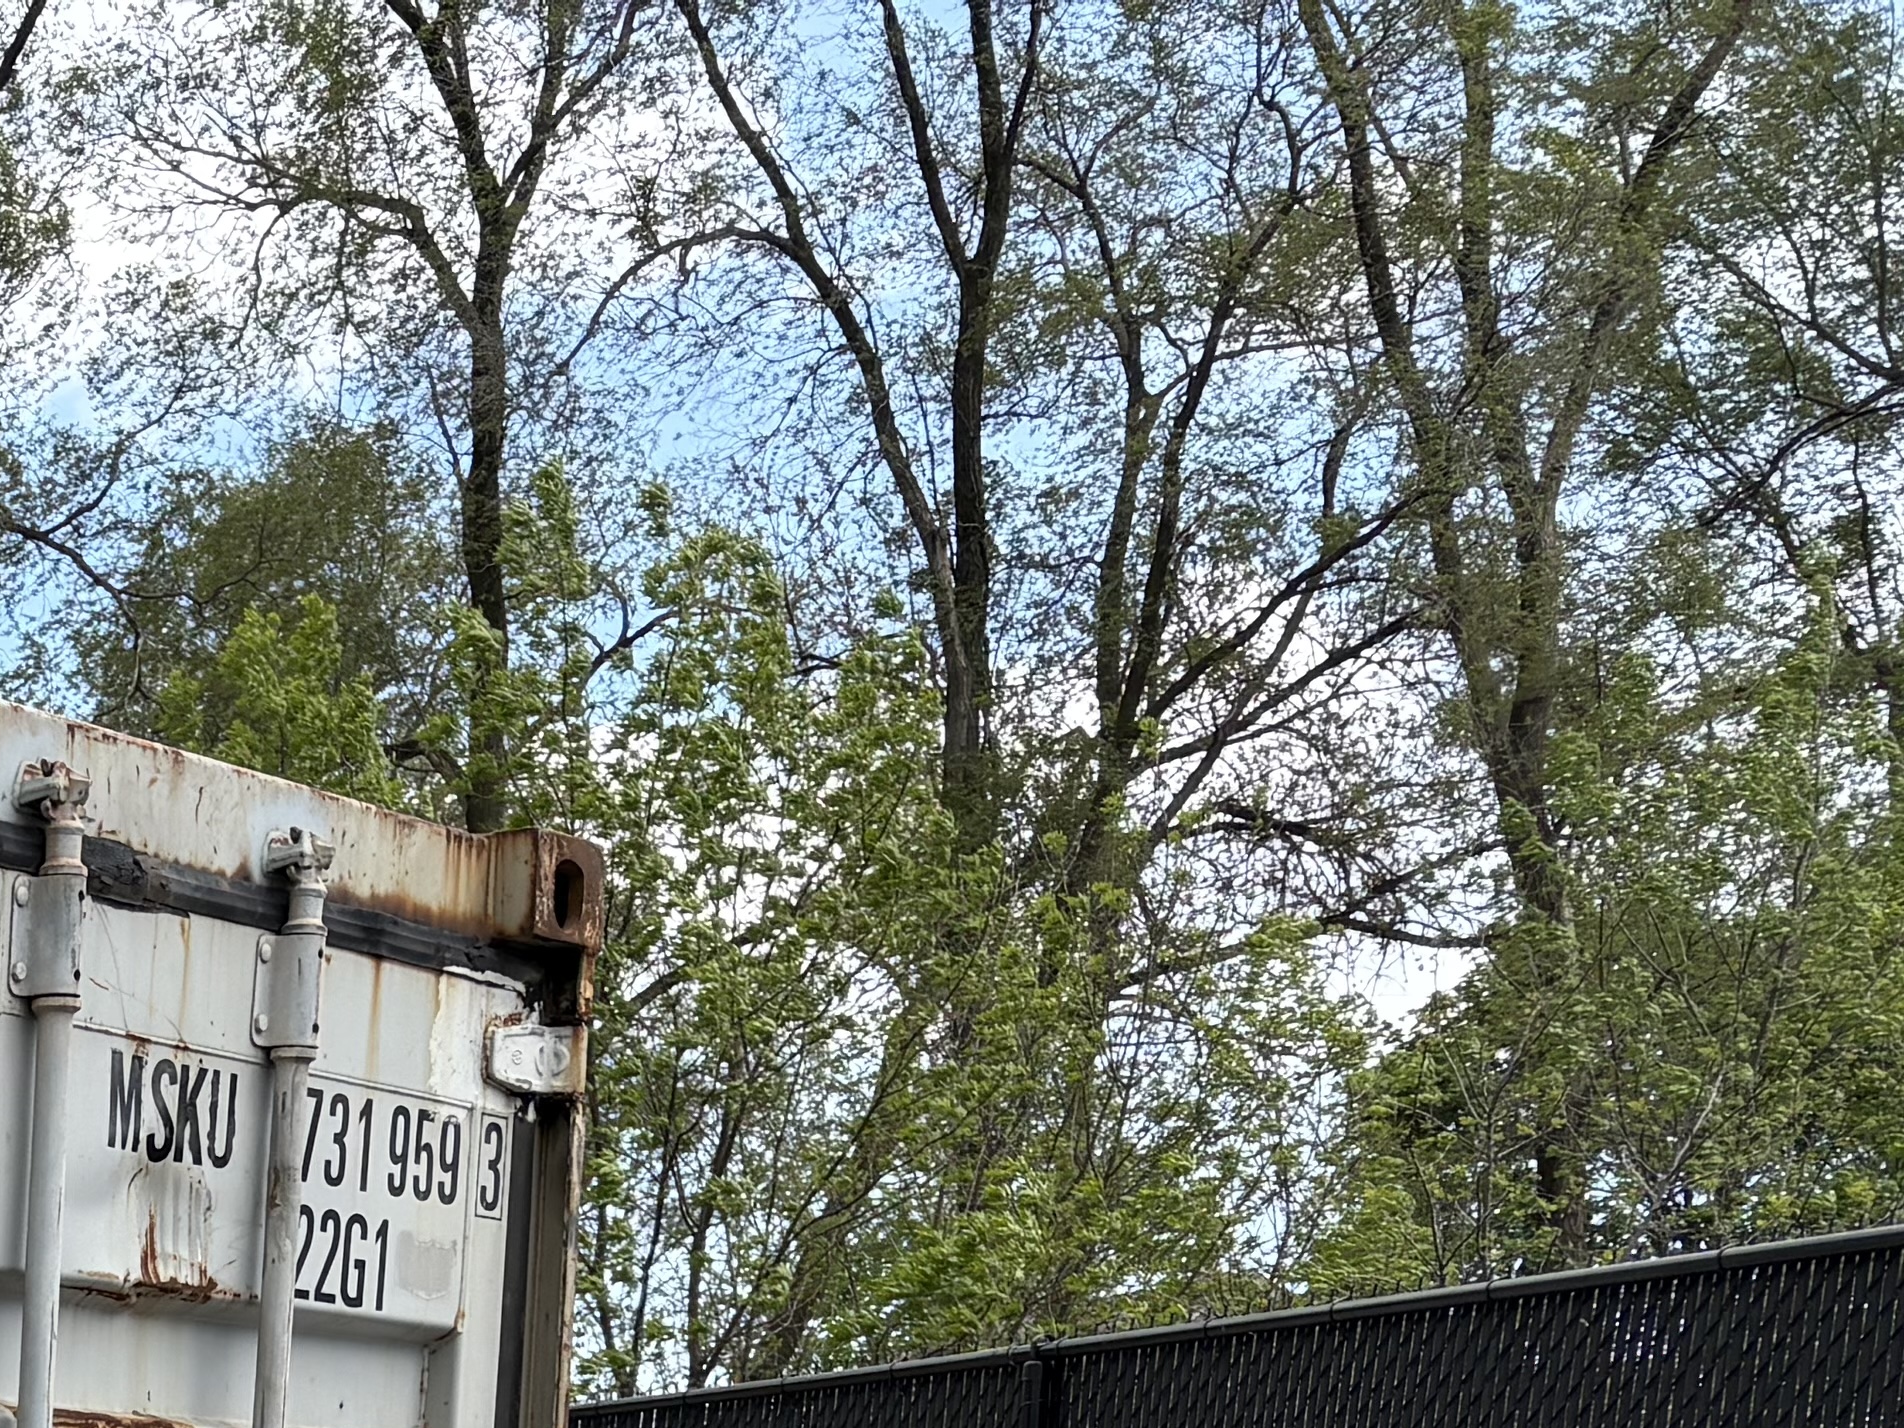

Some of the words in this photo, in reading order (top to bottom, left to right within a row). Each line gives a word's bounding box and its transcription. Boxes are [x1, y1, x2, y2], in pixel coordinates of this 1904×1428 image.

[106, 1047, 239, 1169] MSKU
[387, 1104, 462, 1206] 959
[479, 1121, 505, 1211] 3
[293, 1203, 390, 1311] 22G1
